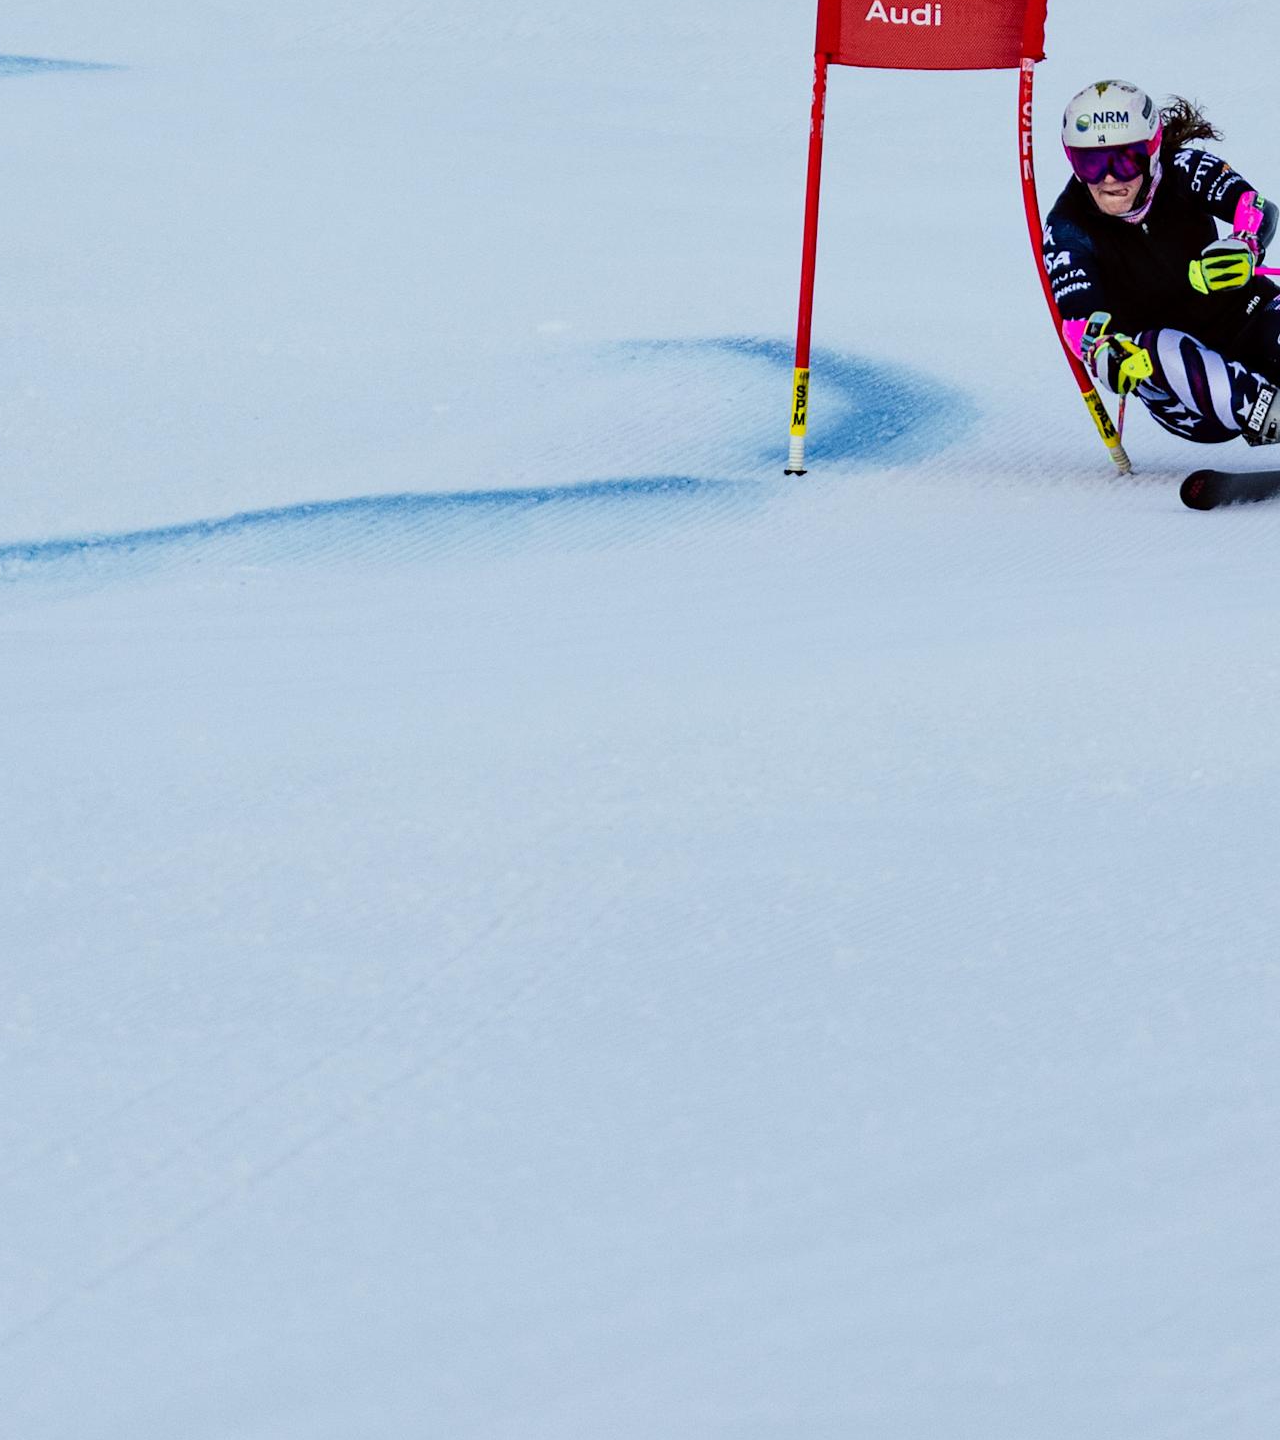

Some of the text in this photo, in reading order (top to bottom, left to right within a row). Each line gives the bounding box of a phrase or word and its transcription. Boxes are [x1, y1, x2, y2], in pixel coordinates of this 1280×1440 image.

[1092, 111, 1129, 124] NRM
[1092, 123, 1129, 131] FERTILITY
[793, 384, 807, 426] SPM
[1247, 388, 1274, 432] BOOSTER
